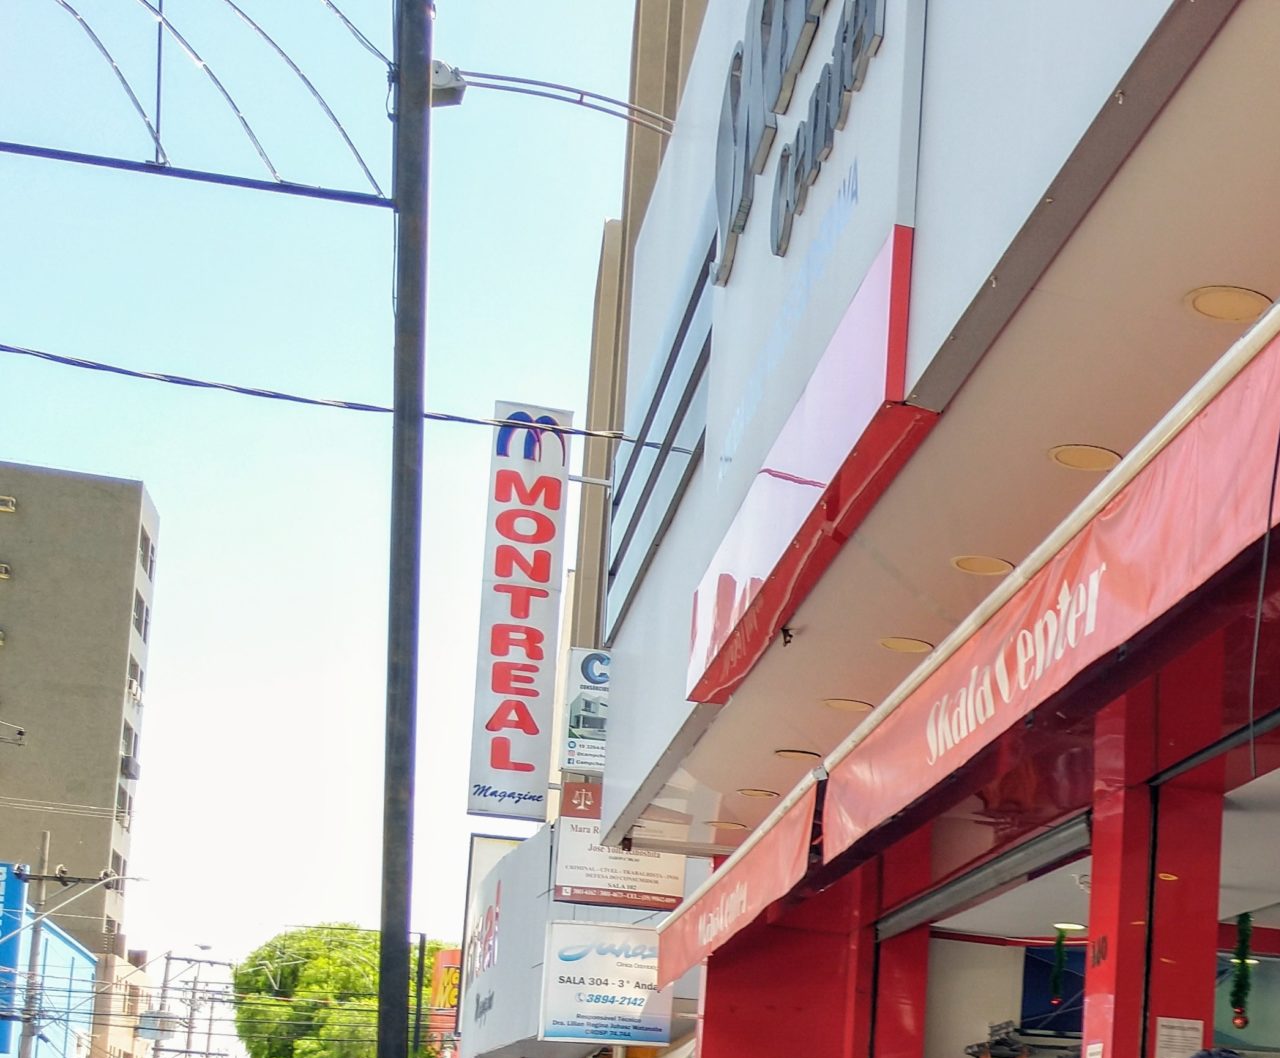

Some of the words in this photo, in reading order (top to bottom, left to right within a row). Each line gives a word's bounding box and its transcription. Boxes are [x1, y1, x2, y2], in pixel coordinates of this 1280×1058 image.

[485, 468, 563, 773] MONTREAL
[995, 562, 1107, 704] Center
[473, 784, 544, 804] Magazine
[558, 975, 585, 985] SALA
[588, 977, 609, 987] 304
[634, 981, 659, 991] Anda
[586, 993, 646, 1007] 3894-2142
